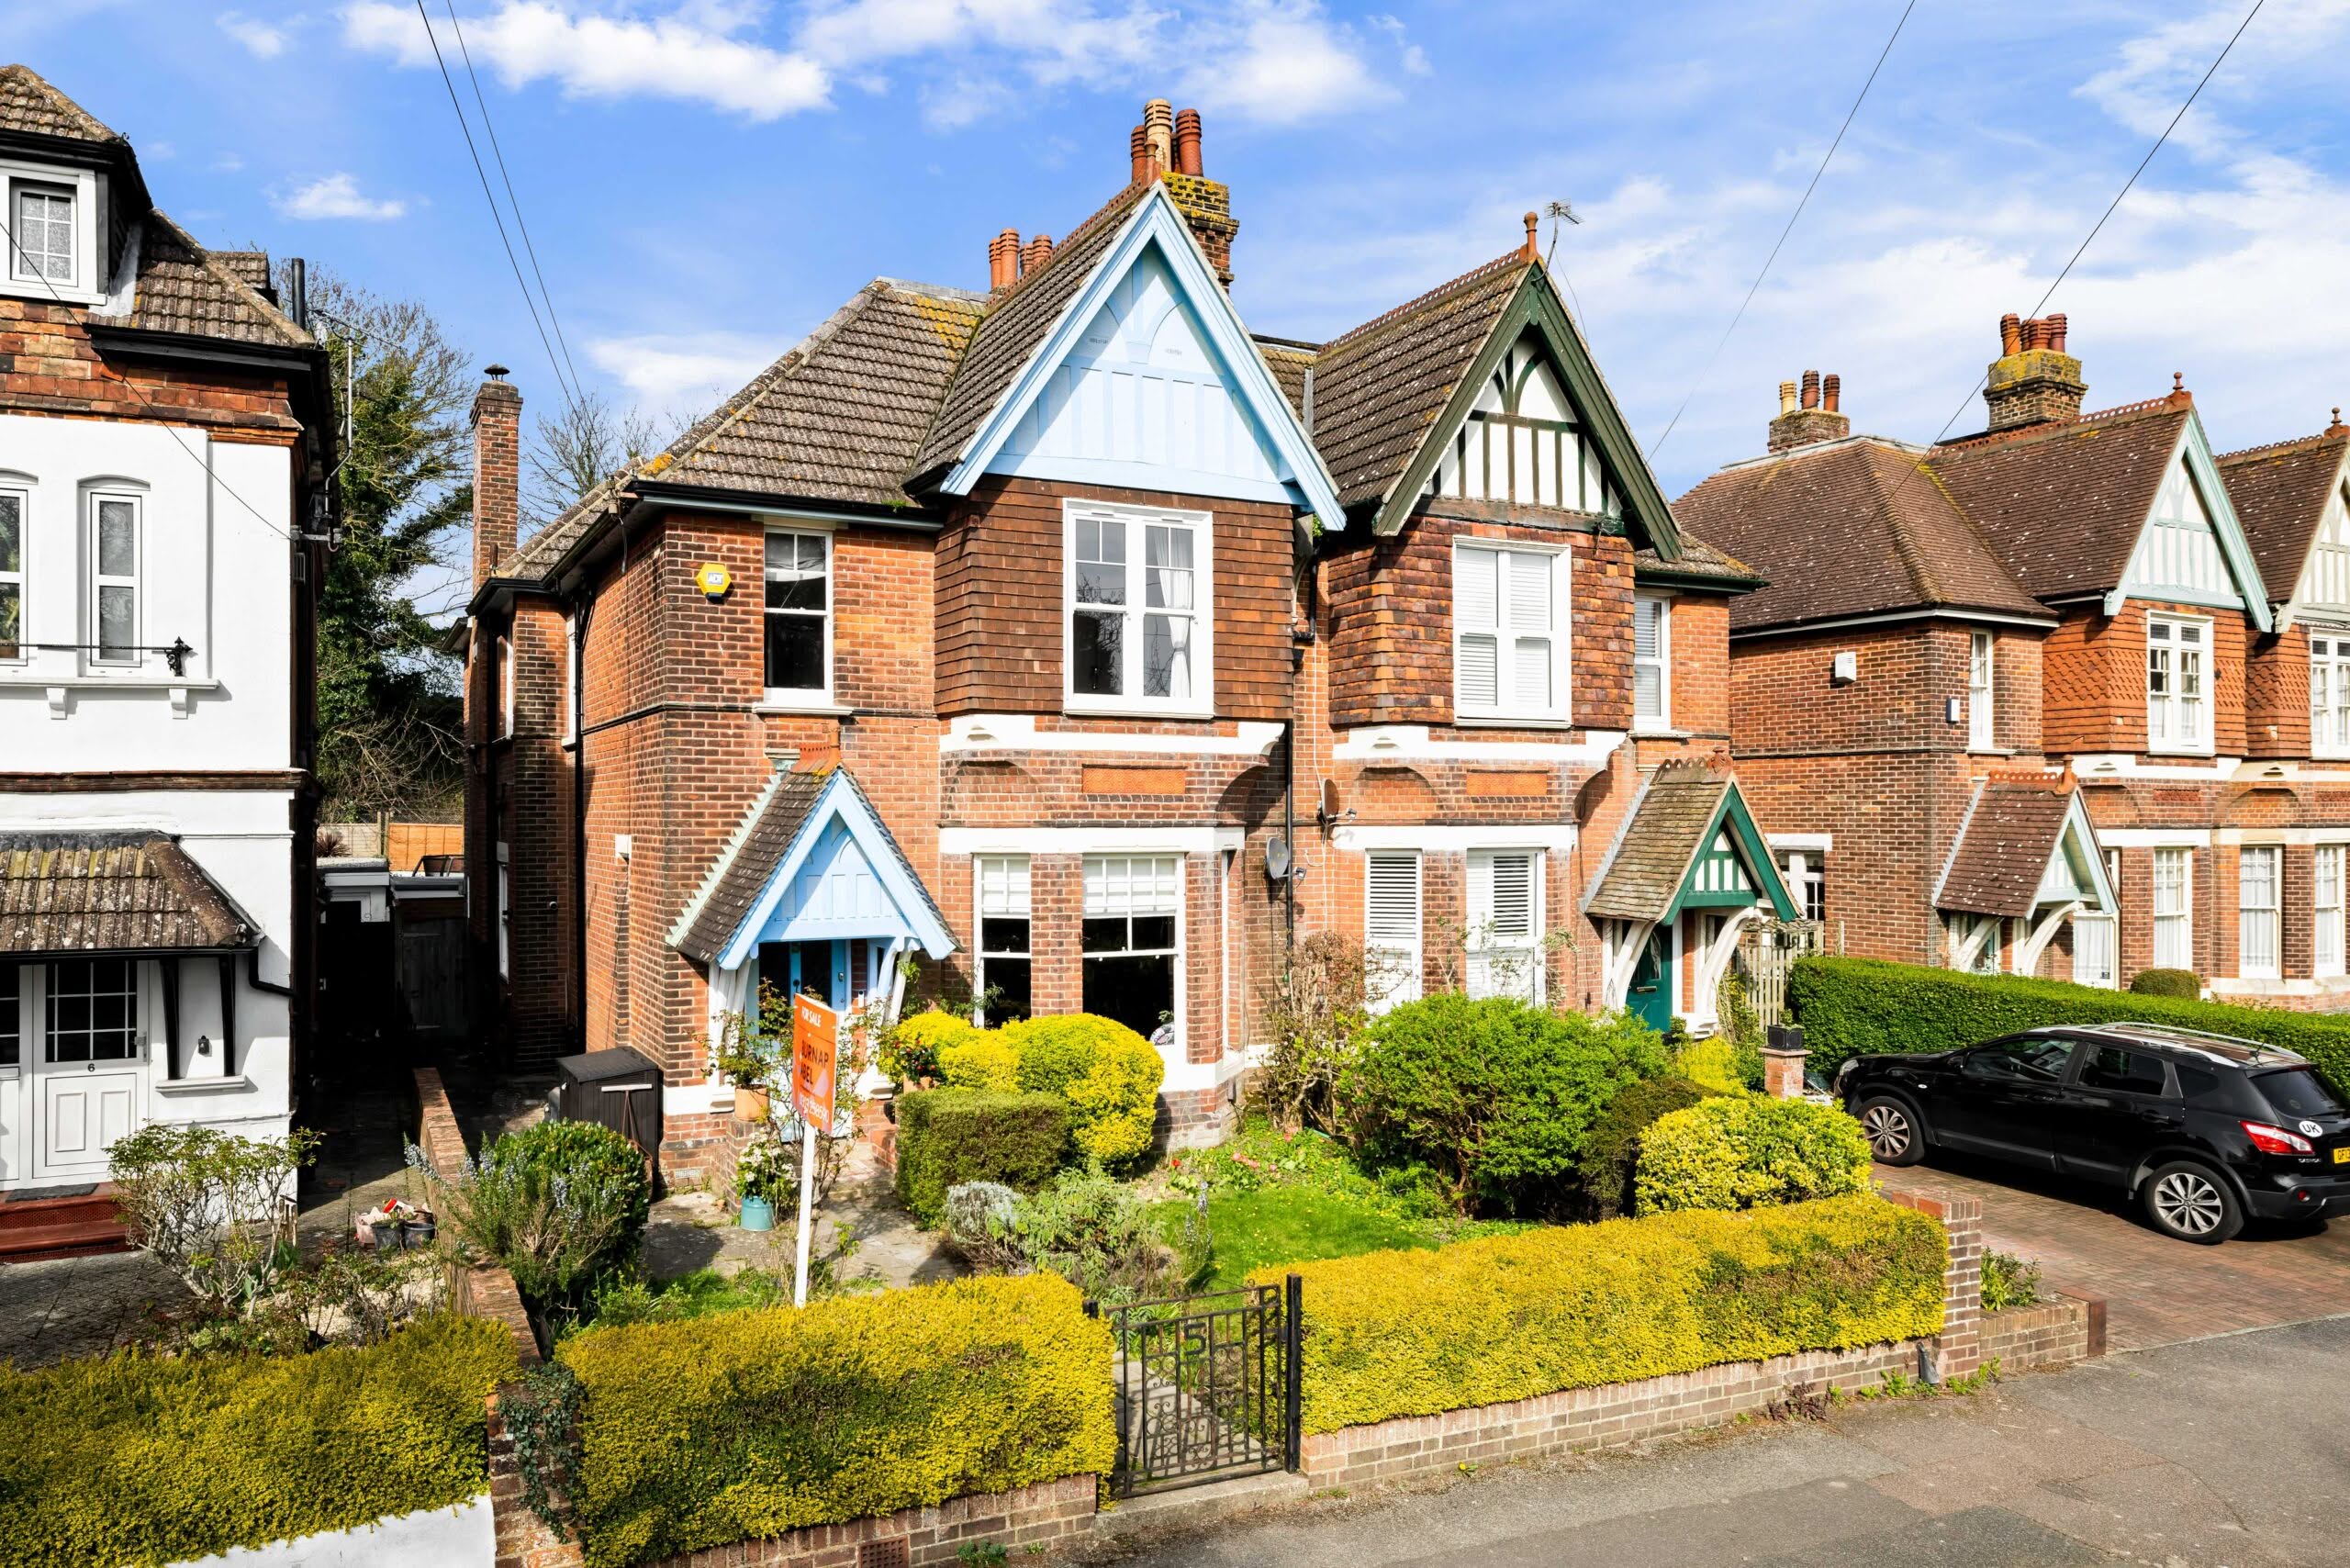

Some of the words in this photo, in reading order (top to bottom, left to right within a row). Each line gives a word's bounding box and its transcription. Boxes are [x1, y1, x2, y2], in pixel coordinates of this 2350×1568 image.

[809, 1010, 821, 1027] SALE
[87, 1063, 95, 1072] 6
[2302, 1125, 2321, 1133] UK
[1184, 1323, 1206, 1355] 5
